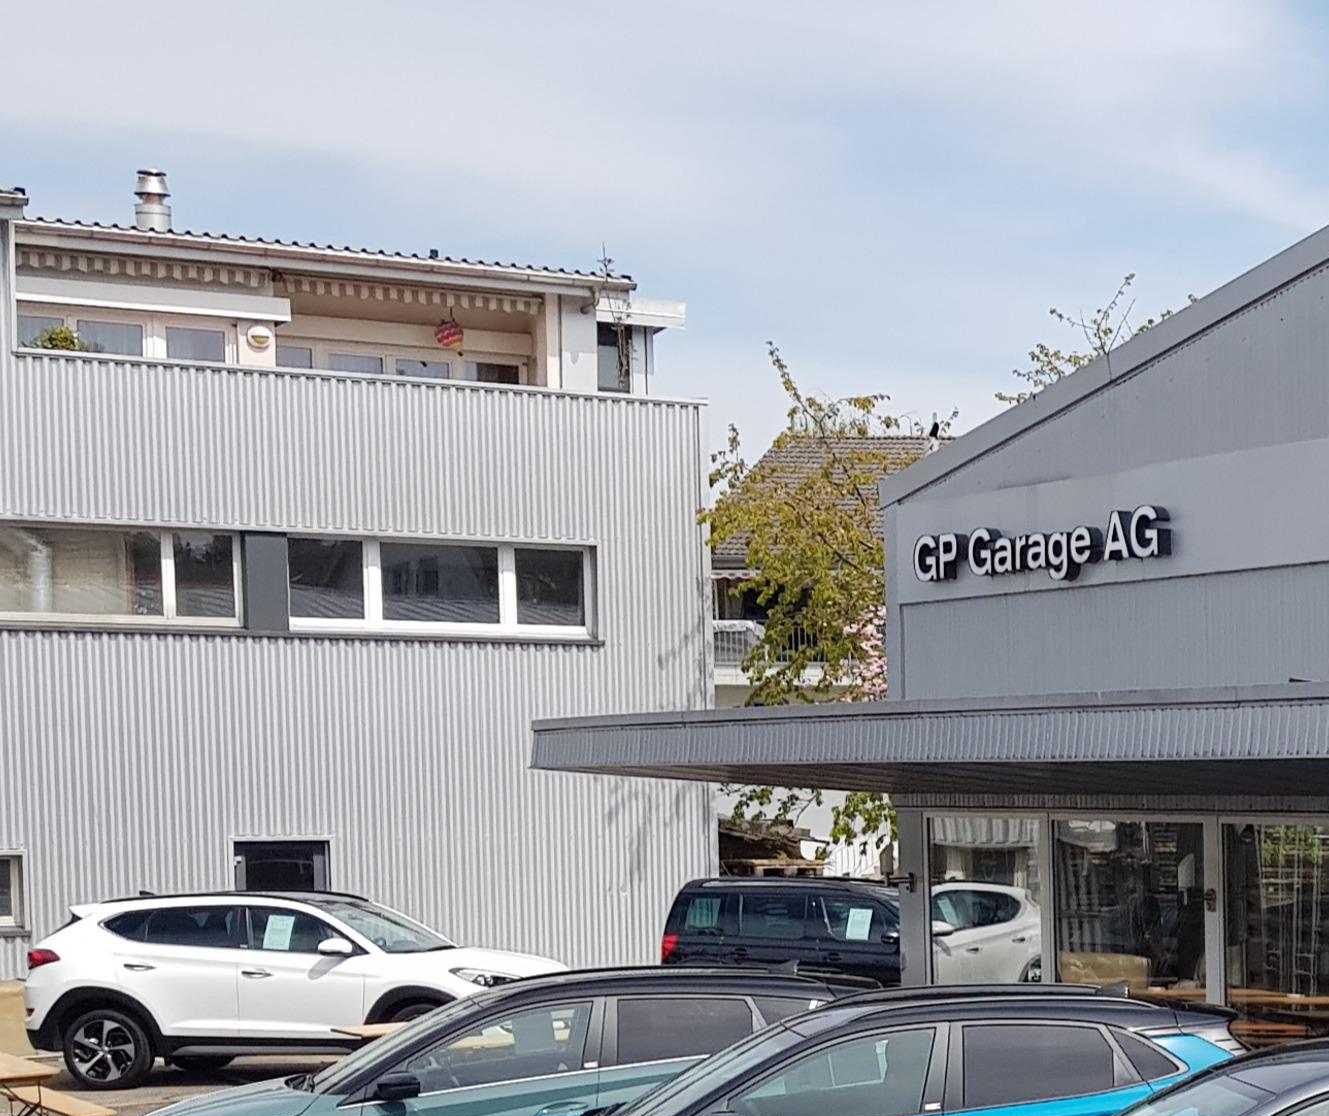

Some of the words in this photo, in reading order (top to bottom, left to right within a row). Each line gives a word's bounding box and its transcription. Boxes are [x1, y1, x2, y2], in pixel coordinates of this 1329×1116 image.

[914, 533, 958, 582] GP
[967, 526, 1093, 582] Garage
[1103, 504, 1162, 562] AG
